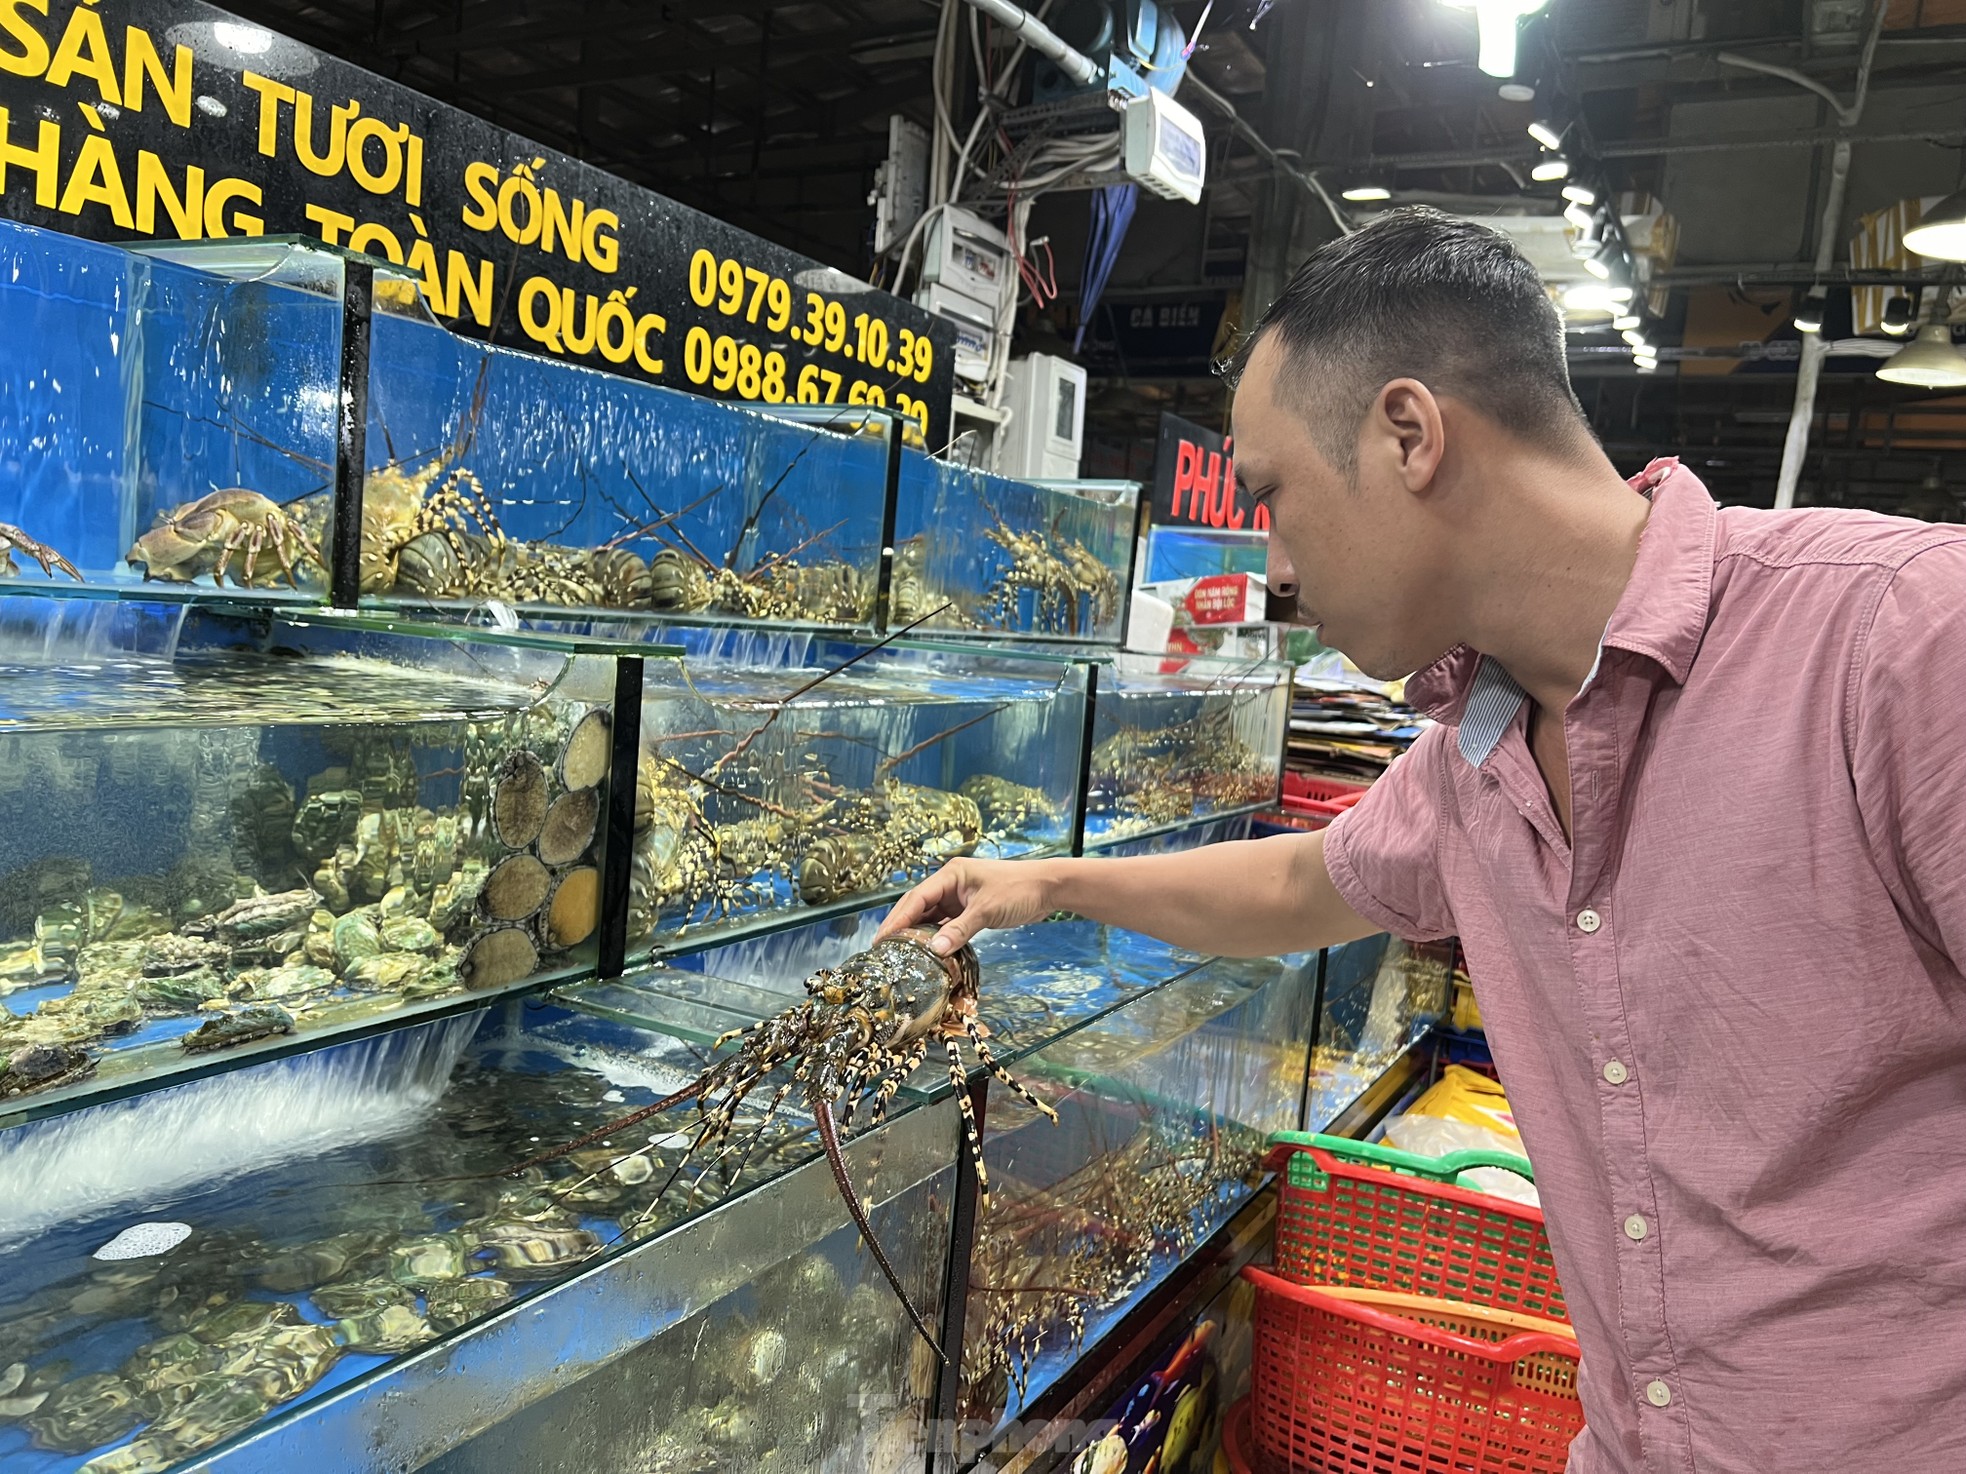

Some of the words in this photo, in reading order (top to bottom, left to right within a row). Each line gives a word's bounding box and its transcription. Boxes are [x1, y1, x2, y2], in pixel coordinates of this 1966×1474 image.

[0, 101, 264, 240] HÀNG
[305, 203, 493, 327] TOÀN
[519, 276, 665, 374] QUỐC
[243, 70, 423, 207] TƯƠI
[462, 157, 619, 273] SỐNG
[689, 249, 932, 382] 0979.39.10.39
